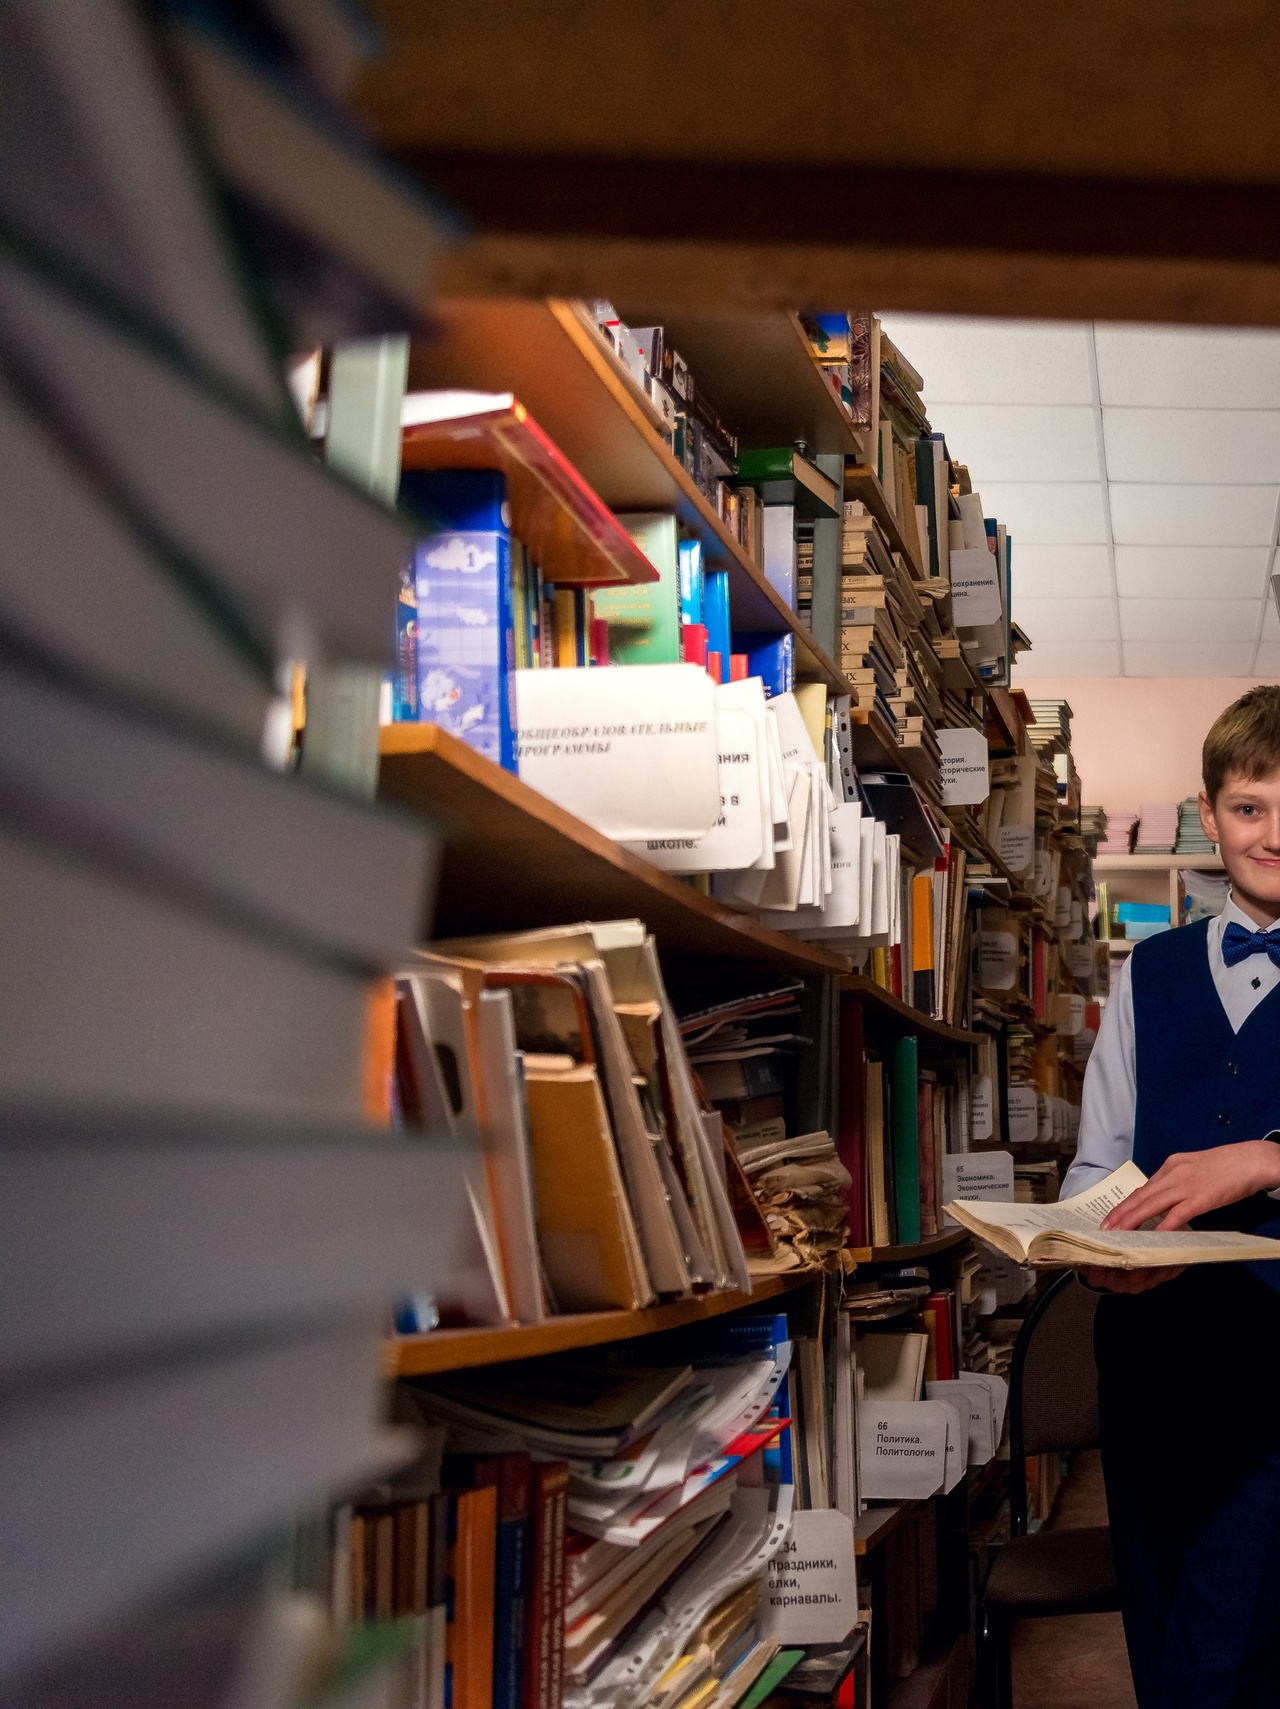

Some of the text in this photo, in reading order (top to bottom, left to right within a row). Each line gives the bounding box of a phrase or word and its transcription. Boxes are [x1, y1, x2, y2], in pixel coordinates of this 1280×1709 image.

[943, 757, 967, 766] тория.
[647, 838, 698, 851] школе.
[955, 1165, 964, 1173] 65
[956, 1174, 996, 1183] Экономика.
[956, 1183, 1010, 1192] Экономические
[959, 1193, 981, 1201] науки.
[877, 1421, 888, 1431] 66
[876, 1434, 922, 1444] Политика.
[875, 1446, 935, 1458] Политология
[777, 1541, 797, 1554] .34
[767, 1559, 838, 1573] Праздники,
[768, 1577, 801, 1590] ёлки,
[769, 1593, 842, 1608] карнавалы.
